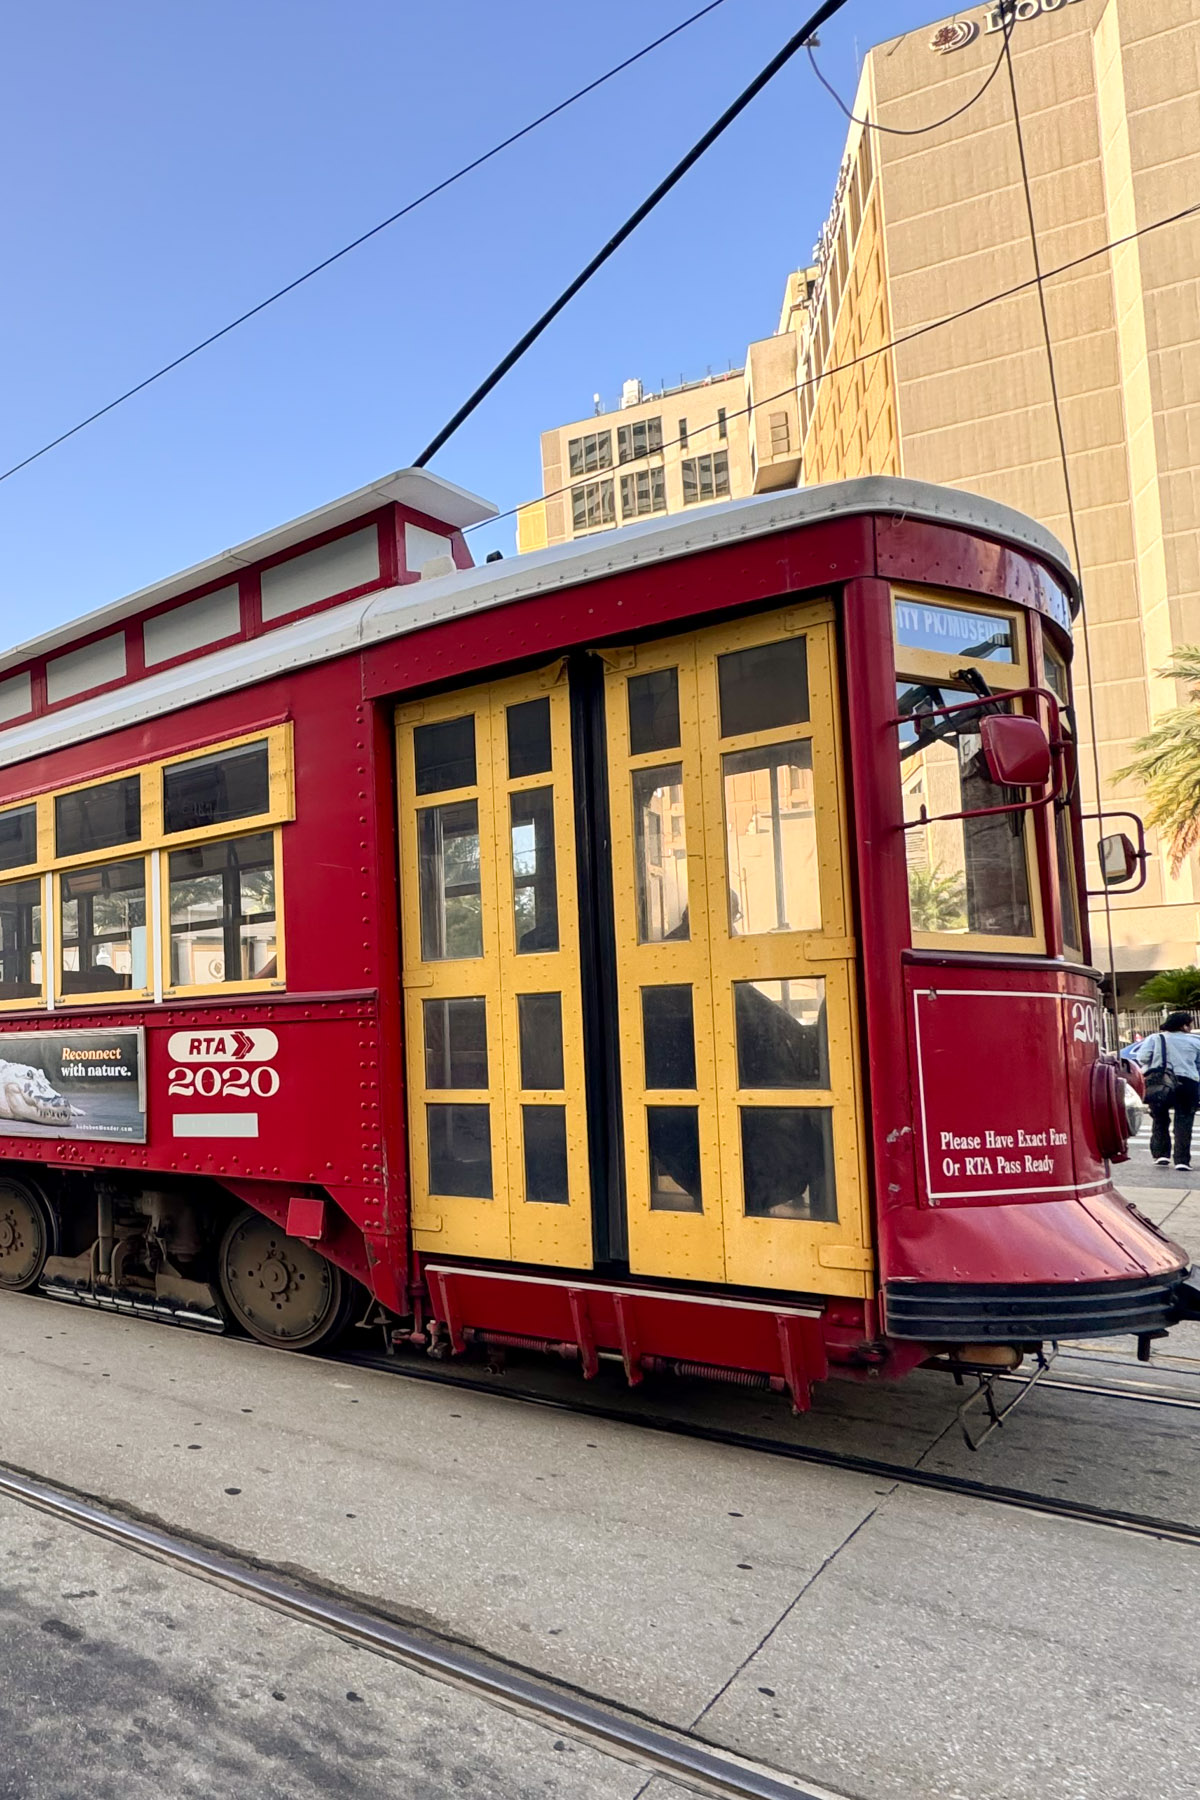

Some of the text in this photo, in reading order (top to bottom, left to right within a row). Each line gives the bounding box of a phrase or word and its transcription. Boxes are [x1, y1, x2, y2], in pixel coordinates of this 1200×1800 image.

[62, 1047, 121, 1060] Reconnect
[189, 1037, 227, 1055] RTA
[61, 1062, 132, 1077] with nature.
[167, 1066, 280, 1098] 2020
[940, 1128, 1068, 1150] Please Have Exact Fare
[942, 1154, 1055, 1177] Or RTA Pass Ready
